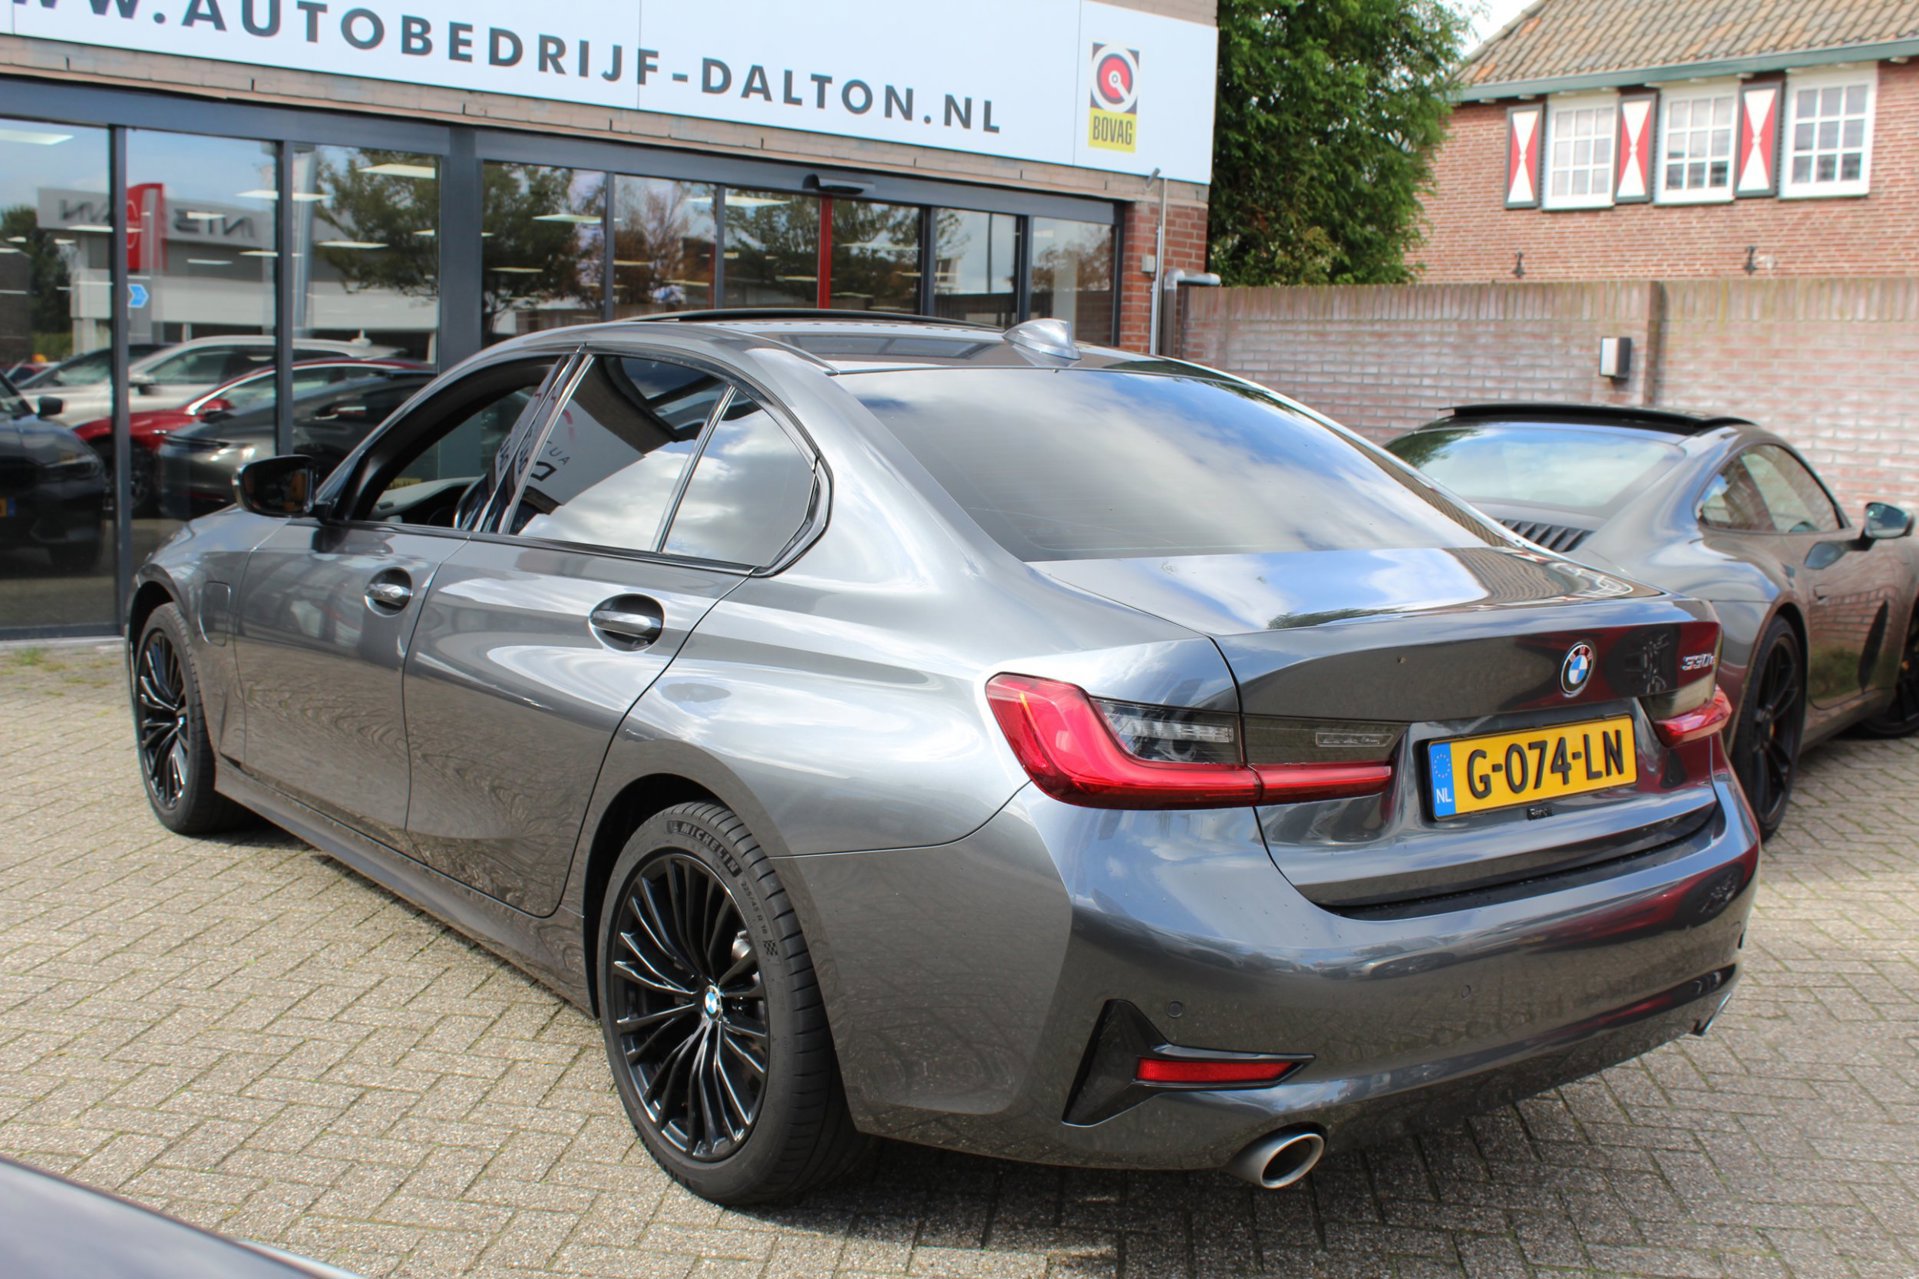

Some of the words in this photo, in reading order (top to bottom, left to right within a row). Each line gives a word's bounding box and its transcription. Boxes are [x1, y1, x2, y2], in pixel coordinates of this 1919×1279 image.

[13, 0, 1001, 134] .AUTOBEDRIJF-DALTON.NL
[1092, 115, 1133, 146] BOVAG
[1466, 729, 1625, 800] G-074-LN
[1435, 787, 1453, 804] NL
[680, 822, 740, 874] MICHELIN
